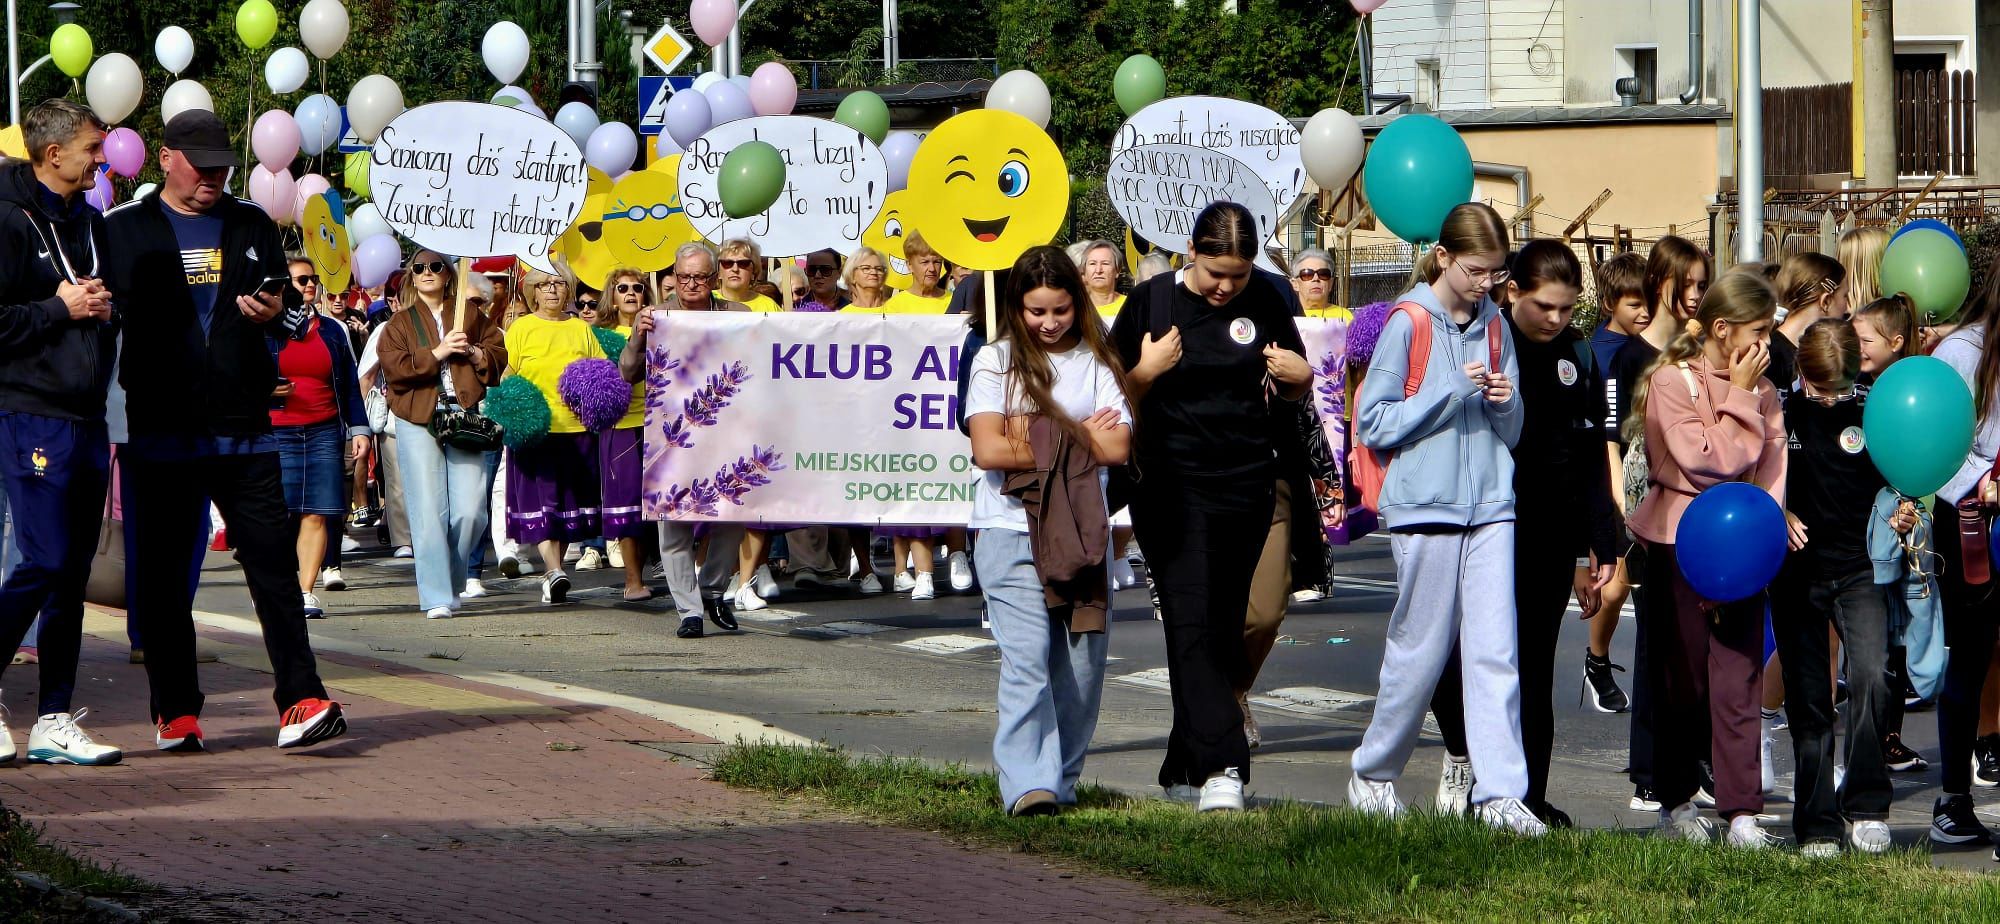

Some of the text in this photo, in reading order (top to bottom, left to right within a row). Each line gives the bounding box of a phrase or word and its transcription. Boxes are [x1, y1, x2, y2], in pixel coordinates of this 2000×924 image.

[808, 128, 866, 183] trzy!
[1202, 110, 1233, 149] dziś
[1240, 122, 1300, 161] ruszajcie
[372, 126, 586, 202] Seniorzy dziś startują!
[1121, 149, 1191, 179] SENIORZY
[381, 181, 474, 238] Zwycięstwa
[782, 181, 808, 215] to
[825, 181, 874, 240] my!
[771, 343, 893, 381] KLUB
[795, 452, 938, 473] MIEJSKIEGO
